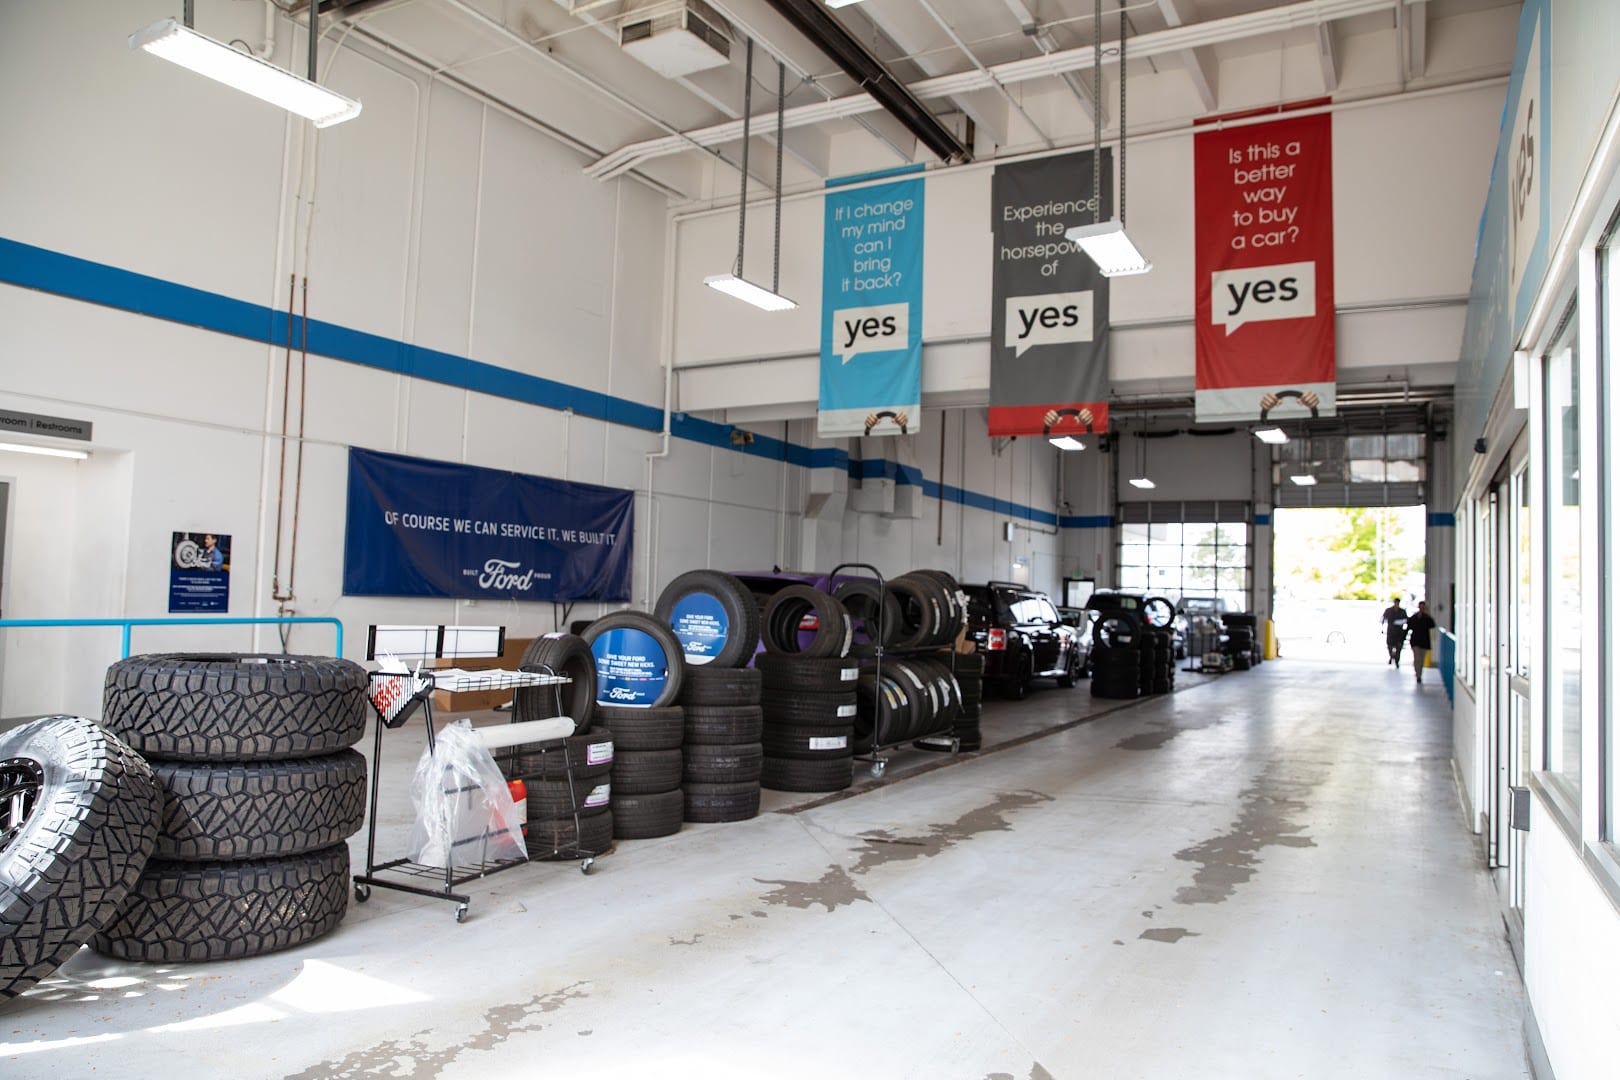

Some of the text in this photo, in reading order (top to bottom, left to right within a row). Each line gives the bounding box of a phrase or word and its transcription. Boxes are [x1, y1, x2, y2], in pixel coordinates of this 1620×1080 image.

[1229, 141, 1301, 164] Is this a
[1234, 162, 1296, 185] better
[1243, 186, 1286, 205] way
[1511, 98, 1534, 285] yes
[835, 198, 913, 221] If I change
[1004, 198, 1096, 221] Experience
[1232, 206, 1298, 227] to buy
[842, 216, 905, 239] my mind
[1036, 221, 1064, 236] the
[1232, 227, 1299, 250] a car?
[854, 236, 891, 255] can I
[854, 257, 891, 274] bring
[1041, 260, 1059, 276] of
[842, 272, 901, 292] it back?
[1227, 276, 1299, 316] yes
[844, 315, 896, 348] yes
[1018, 304, 1079, 339] yes
[0, 417, 26, 426] room
[36, 421, 82, 434] Restrooms
[385, 510, 399, 526] OF
[402, 513, 450, 532] COURSE
[454, 519, 471, 533] WE
[474, 520, 497, 535] CAN
[501, 524, 545, 539] SERVICE
[547, 528, 559, 541] IT.
[561, 530, 577, 543] WE
[579, 531, 604, 544] BUILT
[479, 559, 533, 590] Ford
[610, 687, 636, 700] Ford
